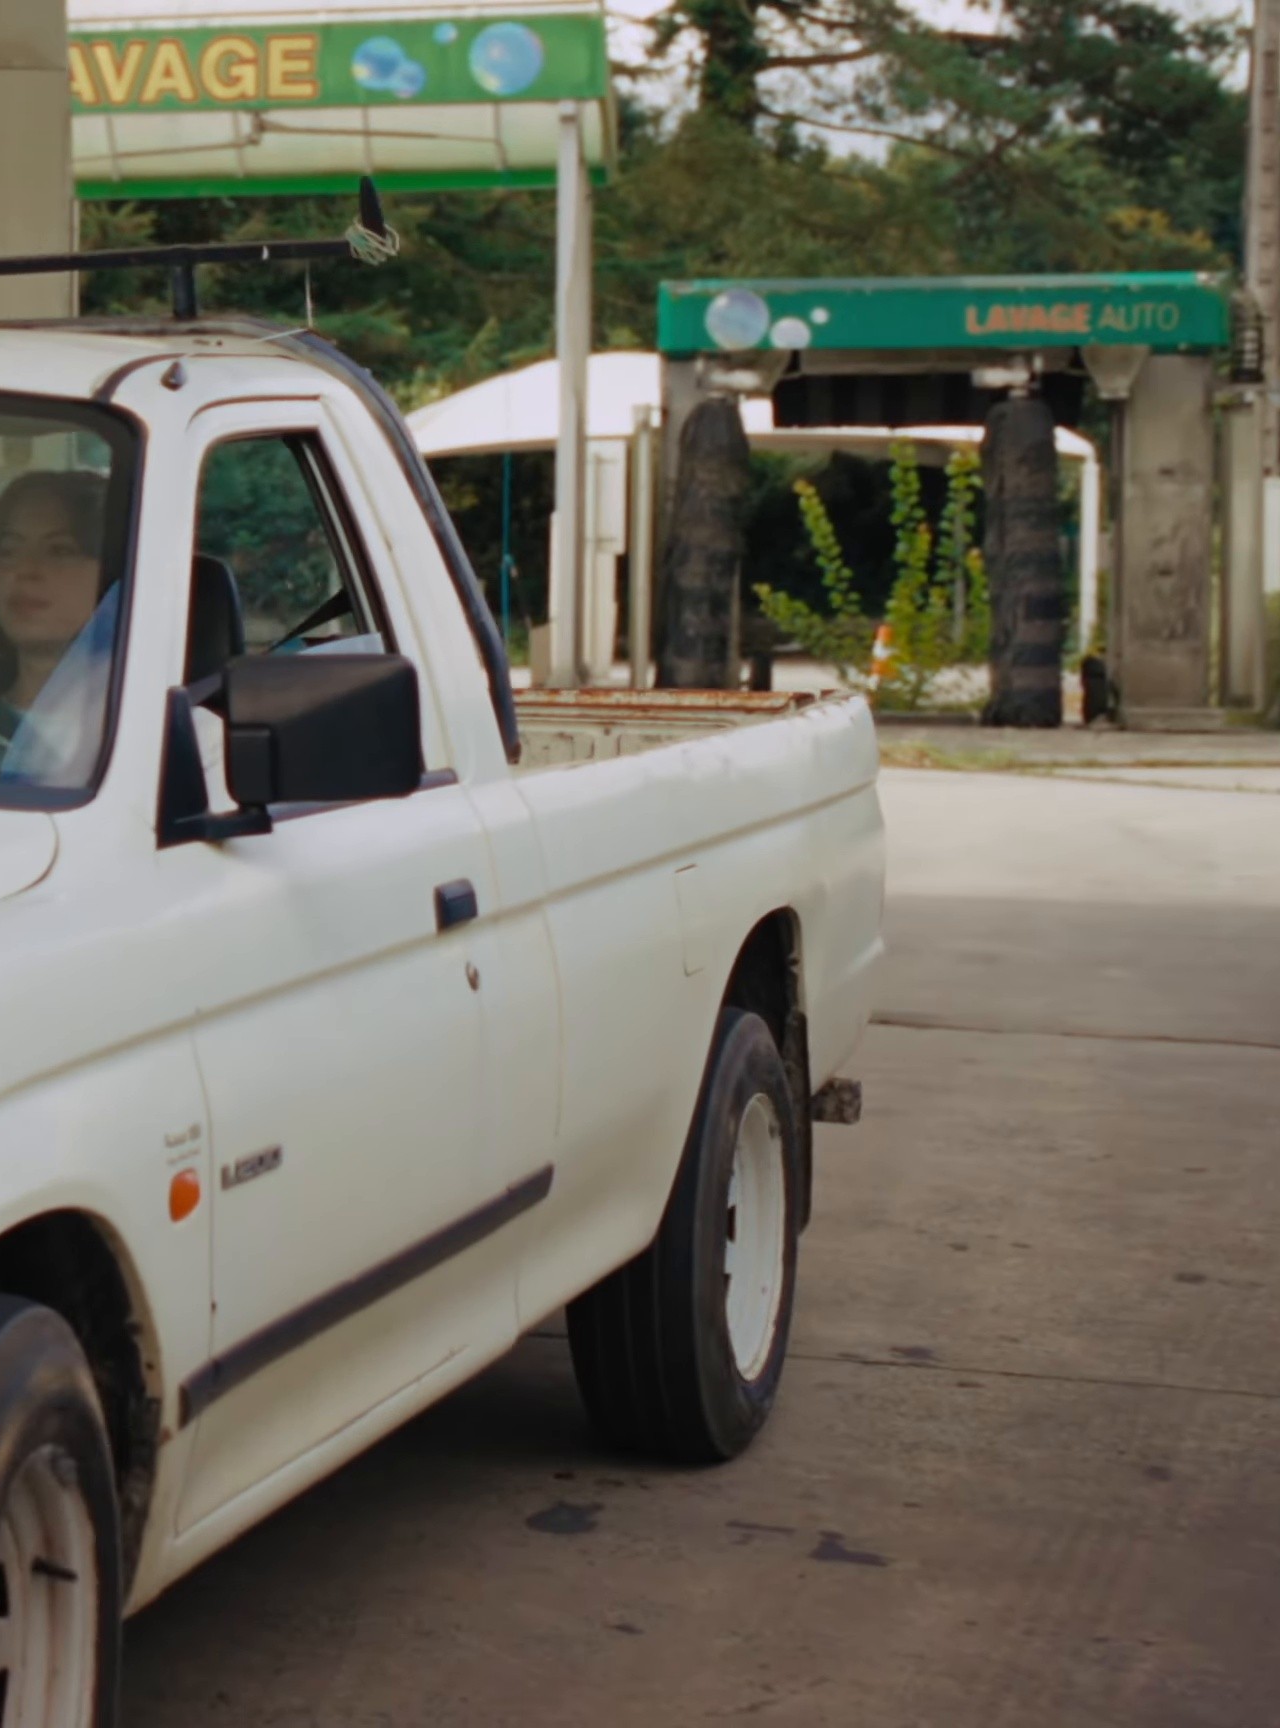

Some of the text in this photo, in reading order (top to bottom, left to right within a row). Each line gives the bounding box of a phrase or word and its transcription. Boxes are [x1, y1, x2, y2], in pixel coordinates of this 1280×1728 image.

[69, 33, 320, 105] AVAGE
[965, 302, 1180, 335] LAVAGE AUTO
